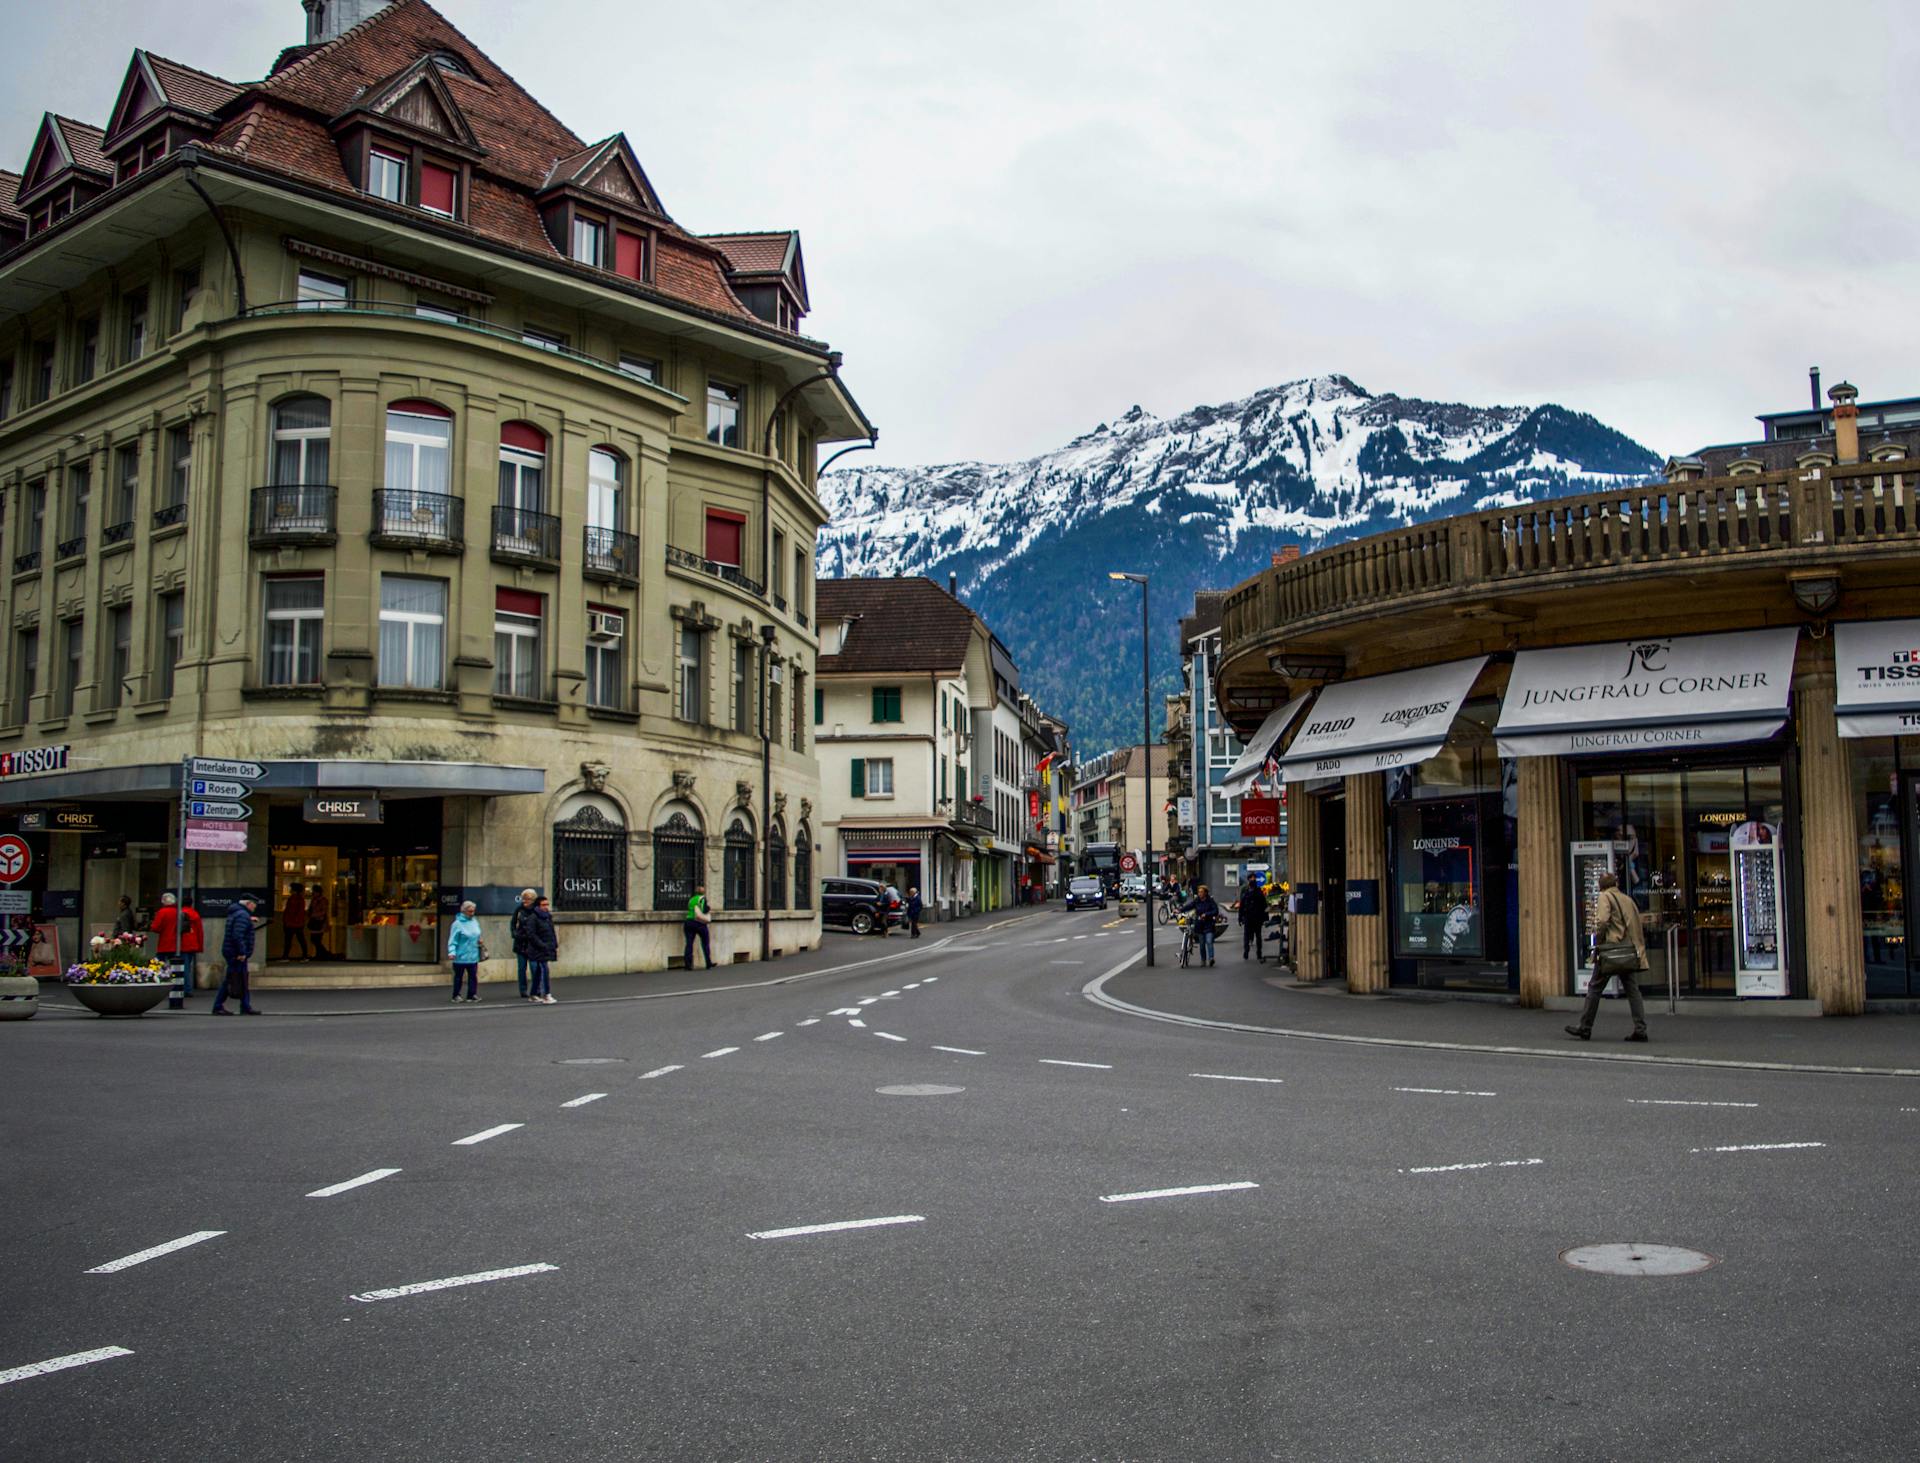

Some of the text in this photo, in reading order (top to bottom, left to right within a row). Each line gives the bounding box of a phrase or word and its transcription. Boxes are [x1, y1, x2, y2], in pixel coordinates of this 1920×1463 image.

[1521, 672, 1770, 709] JUNGFRAU CORNER
[1381, 701, 1451, 724] LONGINES
[1307, 717, 1355, 736] RADO
[1570, 729, 1703, 750] JUNGFRAU CORNER
[11, 746, 65, 774] TISSOT
[1316, 760, 1341, 772] RADO
[1375, 753, 1403, 768] MIDO
[196, 762, 255, 776] Interlaken Ost
[208, 783, 237, 794] Rosen
[206, 804, 239, 815] Zentrum
[317, 801, 360, 813] CHRIST
[57, 813, 94, 824] CHRIST
[1245, 816, 1275, 825] FRICKER
[1700, 813, 1747, 822] LONGINES
[202, 822, 233, 830] HOTELS
[1413, 837, 1460, 850] LONGINES
[563, 878, 602, 892] CHRIST
